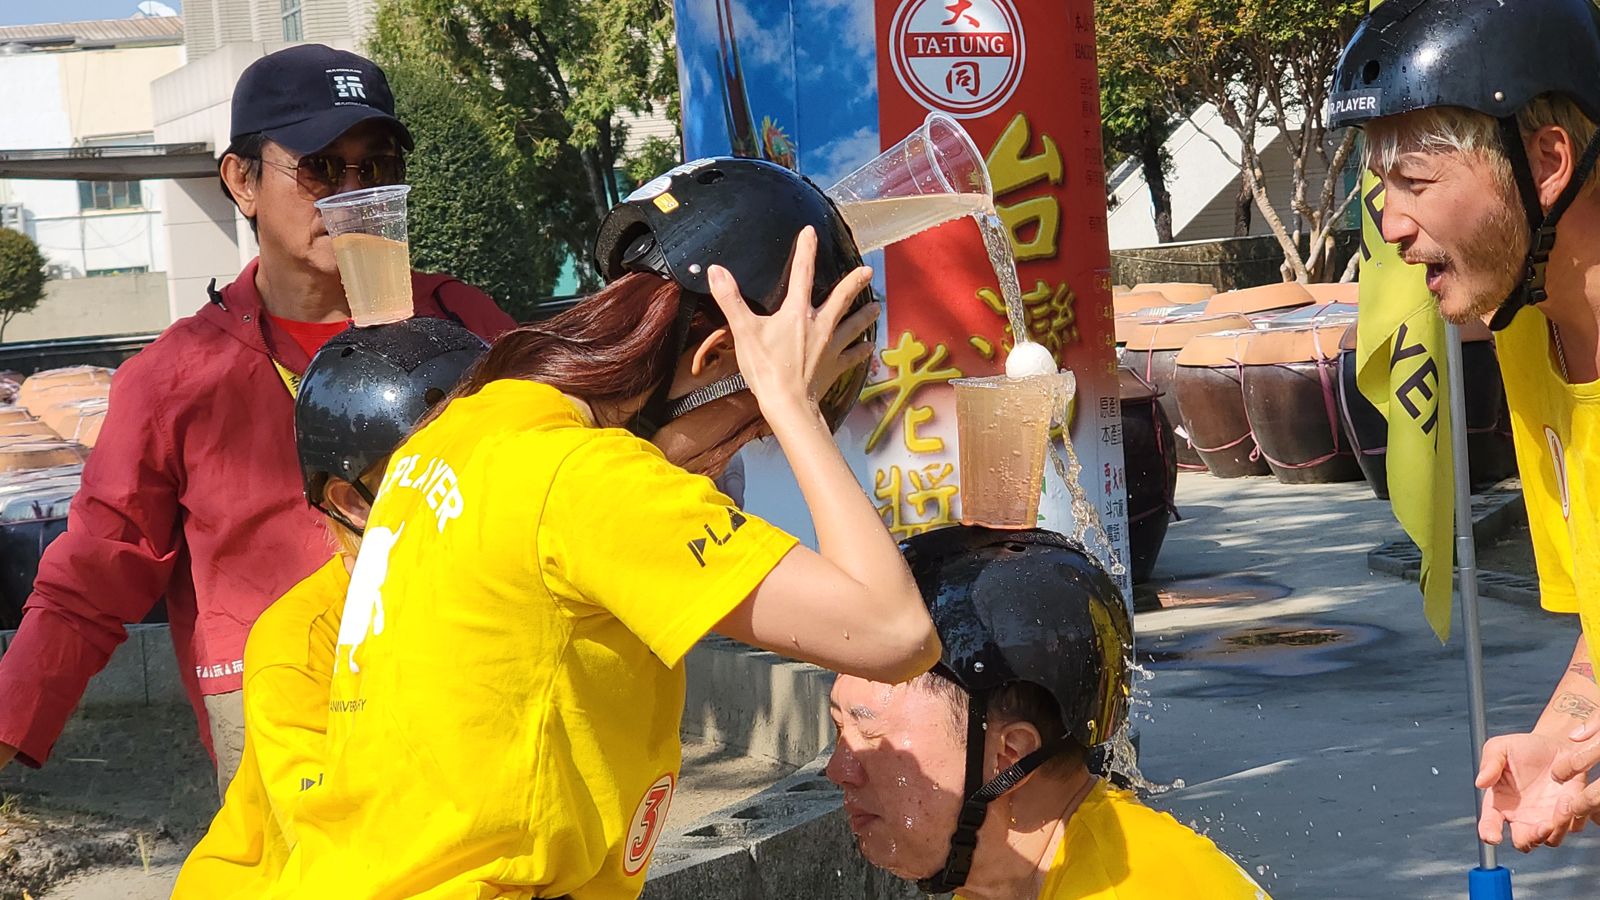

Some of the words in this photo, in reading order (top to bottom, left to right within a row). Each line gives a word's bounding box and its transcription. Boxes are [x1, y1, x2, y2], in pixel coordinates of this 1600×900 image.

[941, 0, 980, 28] 大
[913, 36, 1005, 54] TA-TUNG
[945, 61, 981, 97] 同
[629, 783, 670, 862] 3
